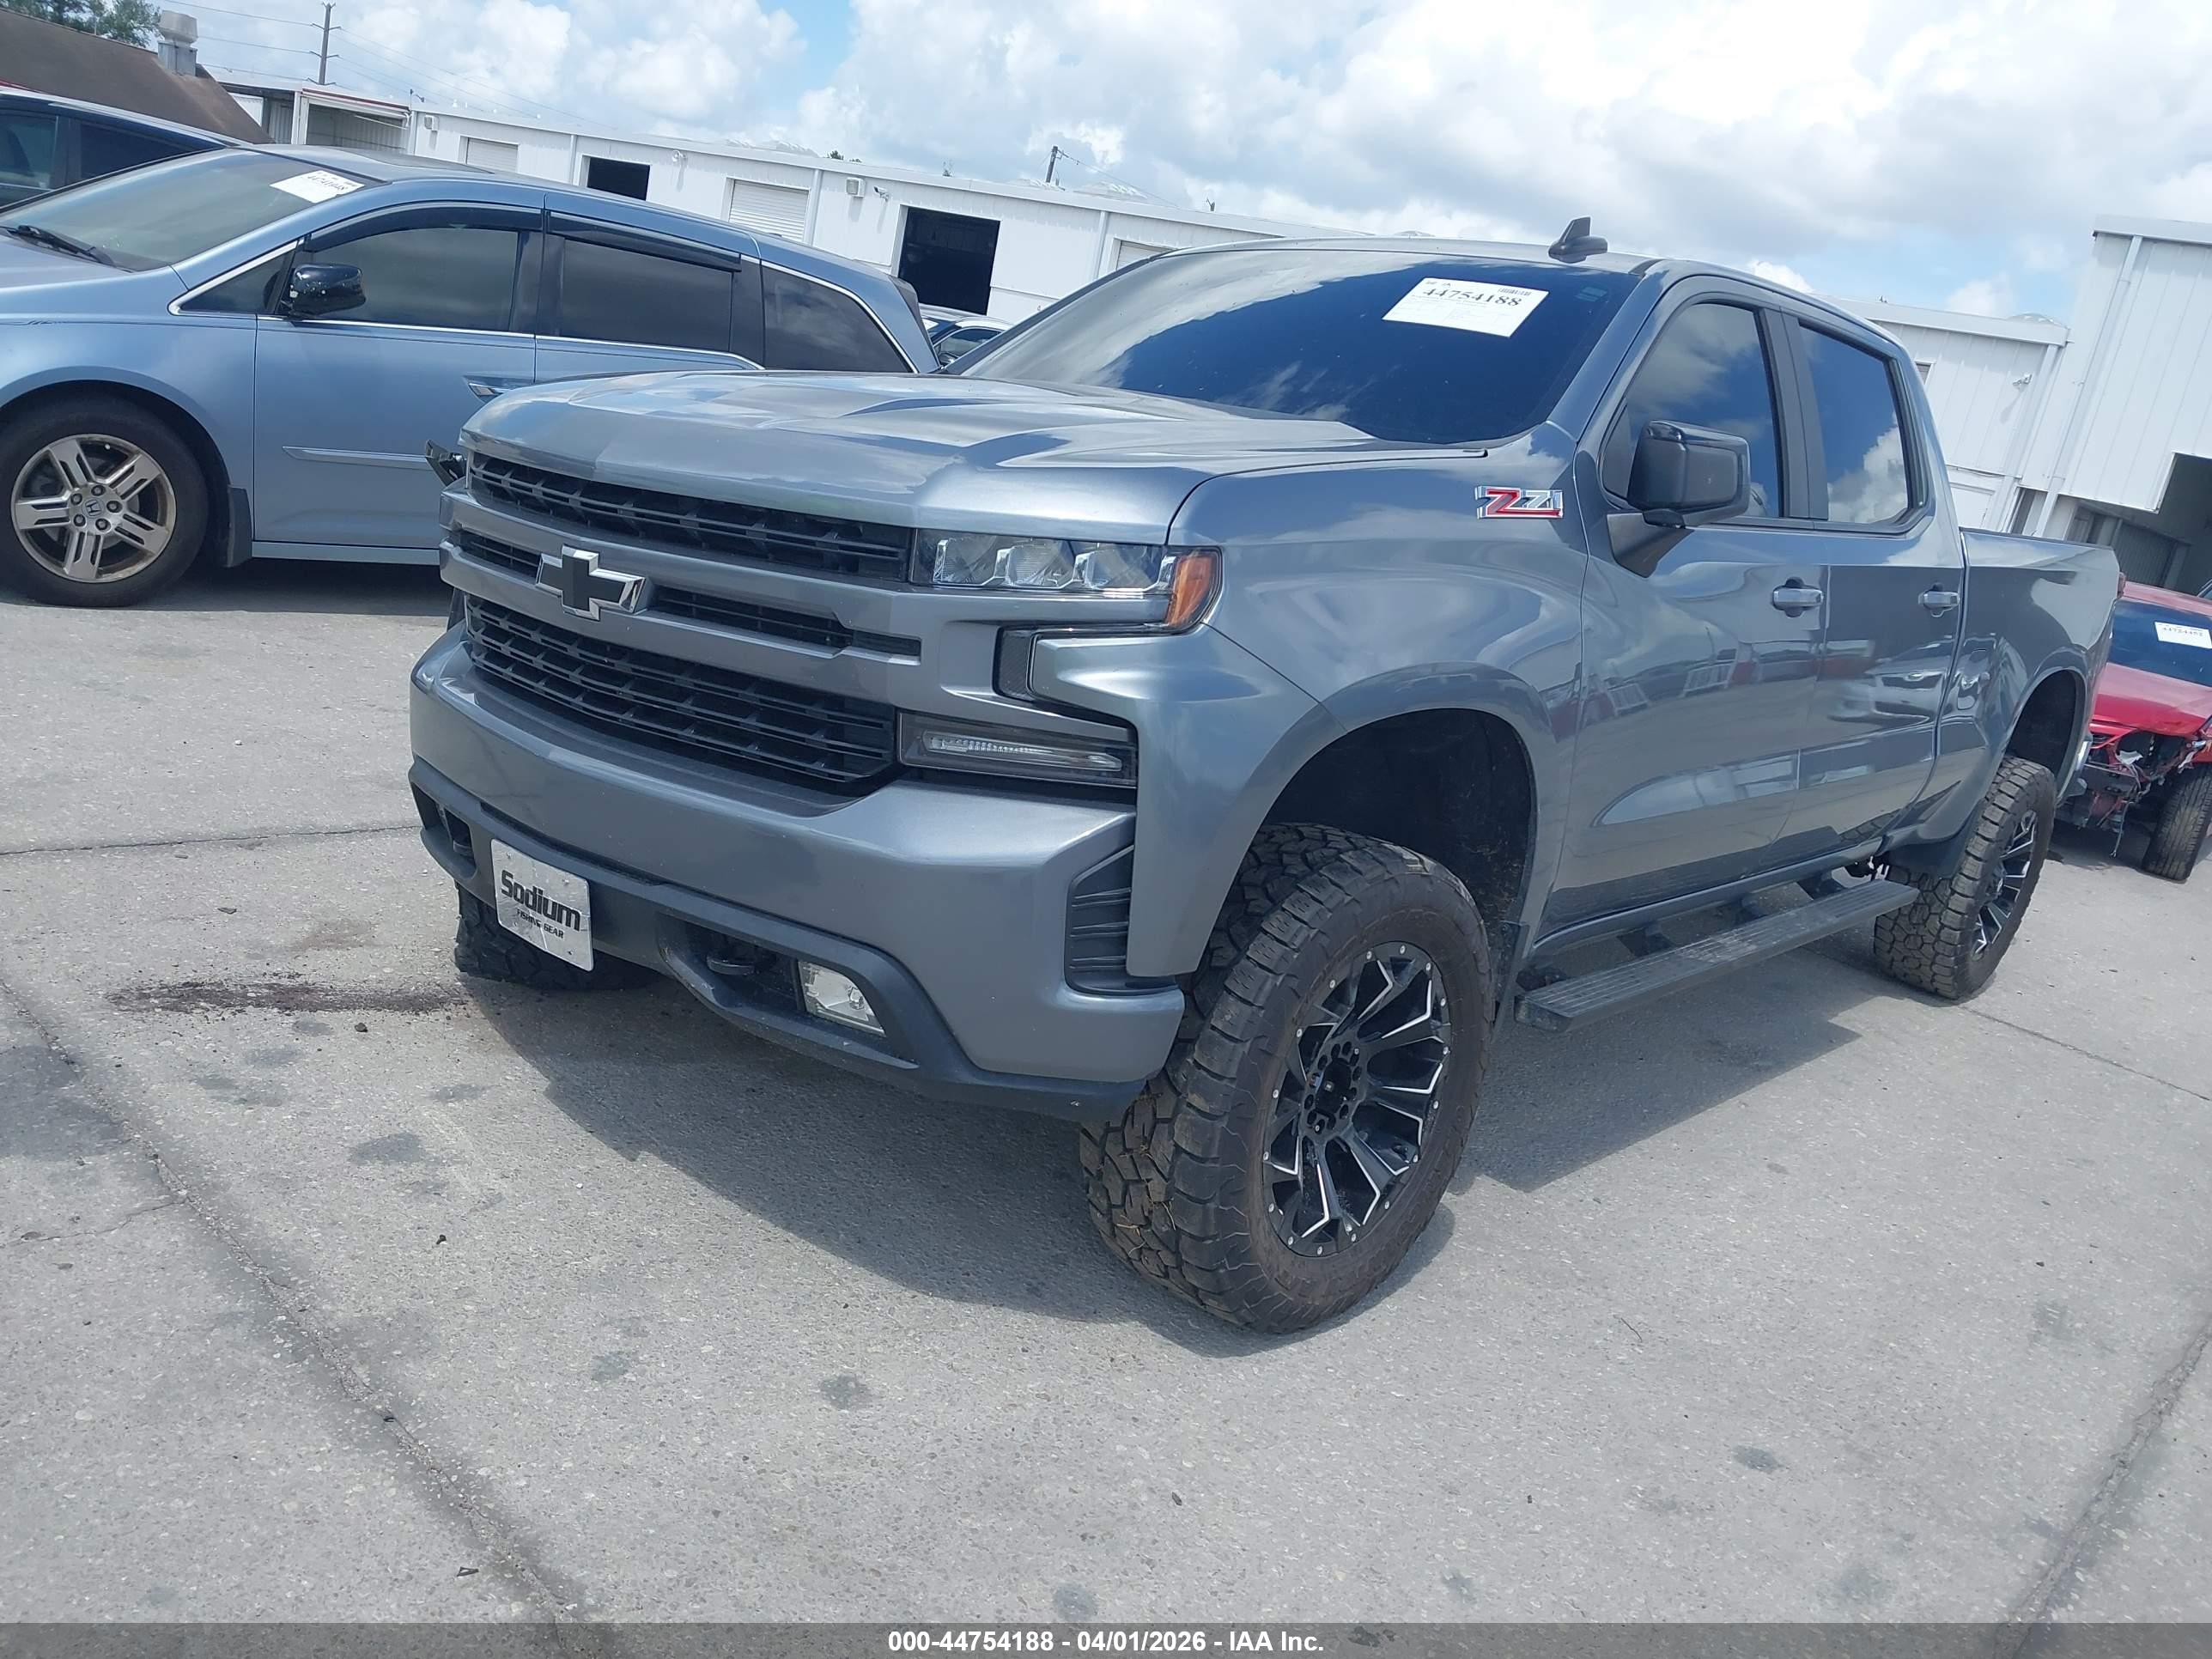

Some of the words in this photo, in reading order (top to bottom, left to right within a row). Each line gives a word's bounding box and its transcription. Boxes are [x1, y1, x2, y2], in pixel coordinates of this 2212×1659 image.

[1423, 289, 1522, 307] 44754188
[1474, 485, 1563, 519] Z71
[501, 869, 581, 932] Sodium
[516, 908, 541, 928] FISHING
[544, 922, 564, 939] GEAR
